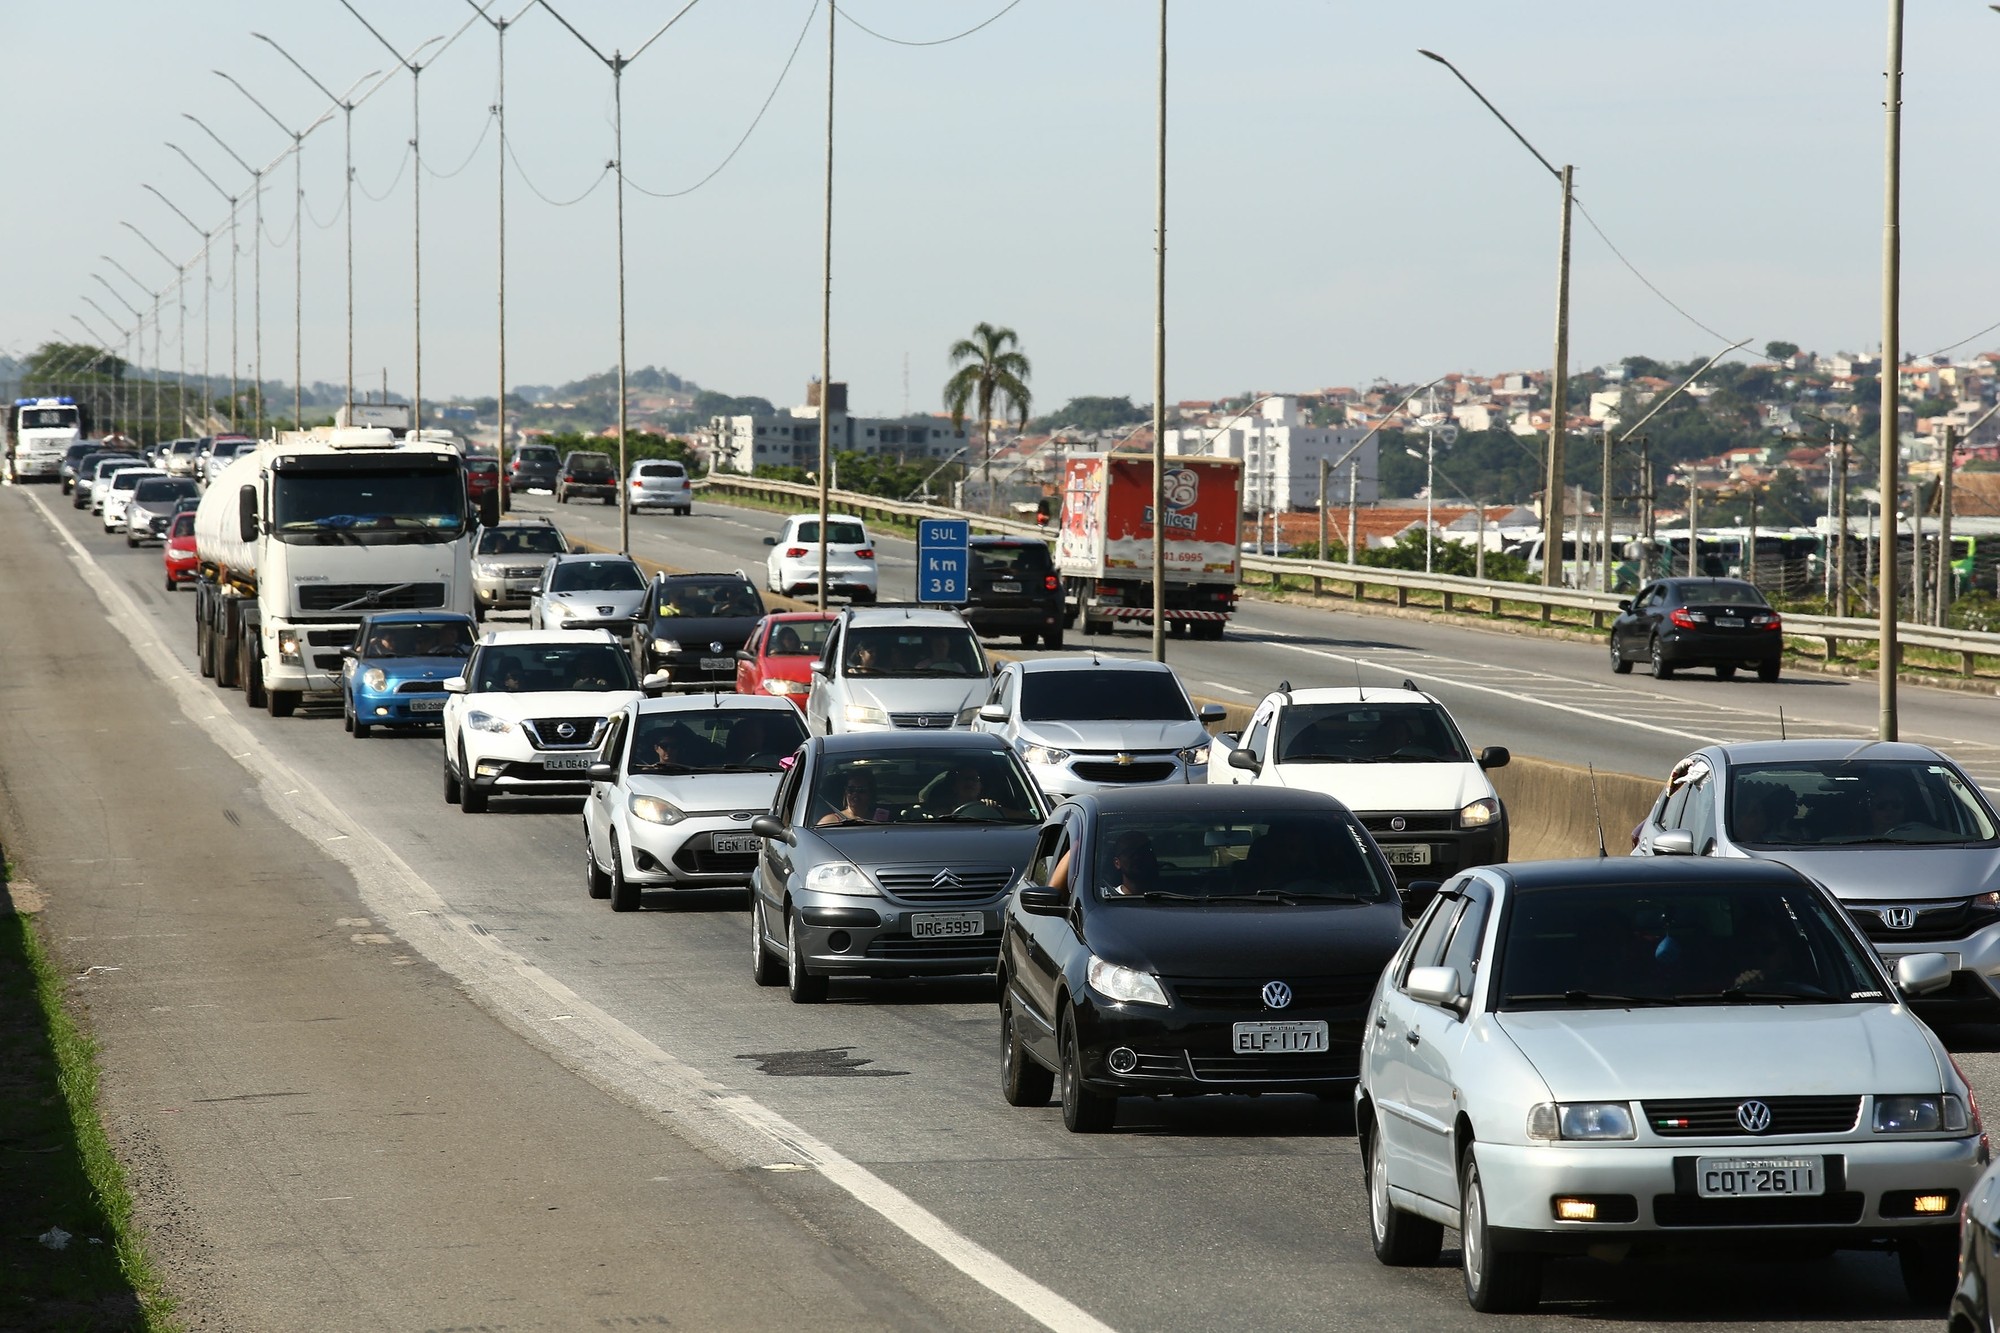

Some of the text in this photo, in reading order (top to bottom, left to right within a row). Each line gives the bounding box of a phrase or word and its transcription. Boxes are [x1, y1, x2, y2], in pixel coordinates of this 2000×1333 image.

[931, 528, 957, 540] SUL
[930, 557, 957, 571] km
[930, 578, 955, 593] 38
